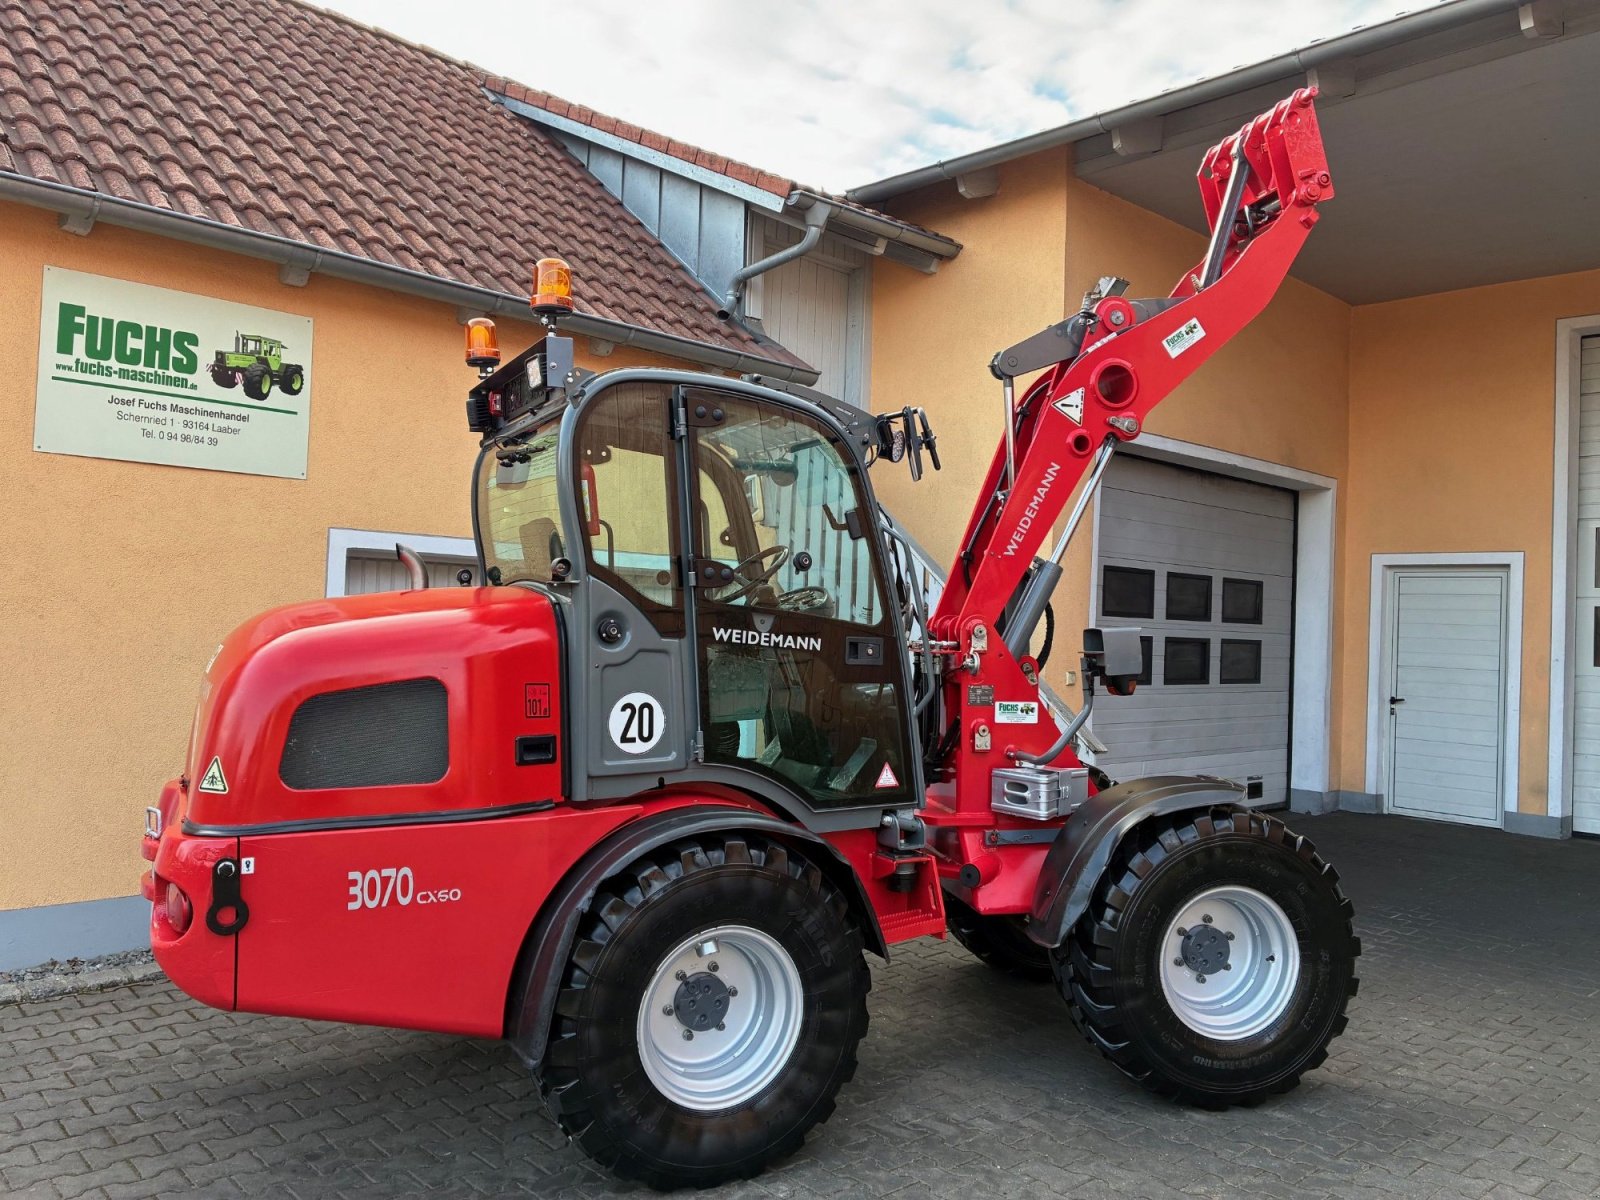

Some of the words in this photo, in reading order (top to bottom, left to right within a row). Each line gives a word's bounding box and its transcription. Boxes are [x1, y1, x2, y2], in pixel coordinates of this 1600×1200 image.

[56, 301, 199, 375] FUCHS
[1165, 330, 1185, 347] FUCHS
[55, 358, 198, 391] www.fuchs-maschinen.de
[108, 394, 136, 407] Josef
[138, 399, 167, 412] Fuchs
[170, 403, 250, 423] Maschinenhandel
[116, 410, 167, 426] Schernried
[170, 418, 174, 427] 1
[182, 419, 209, 432] 93164
[211, 423, 241, 435] Laaber
[140, 428, 156, 439] Tel.
[158, 430, 165, 440] 0
[166, 432, 178, 442] 94
[180, 433, 205, 444] 98/84
[207, 437, 219, 446] 39
[1003, 461, 1061, 556] WEIDEMANN
[712, 626, 822, 651] WEIDEMANN
[528, 698, 542, 716] 101
[998, 703, 1019, 711] FUCHS
[619, 702, 654, 744] 20
[347, 866, 414, 911] 3070
